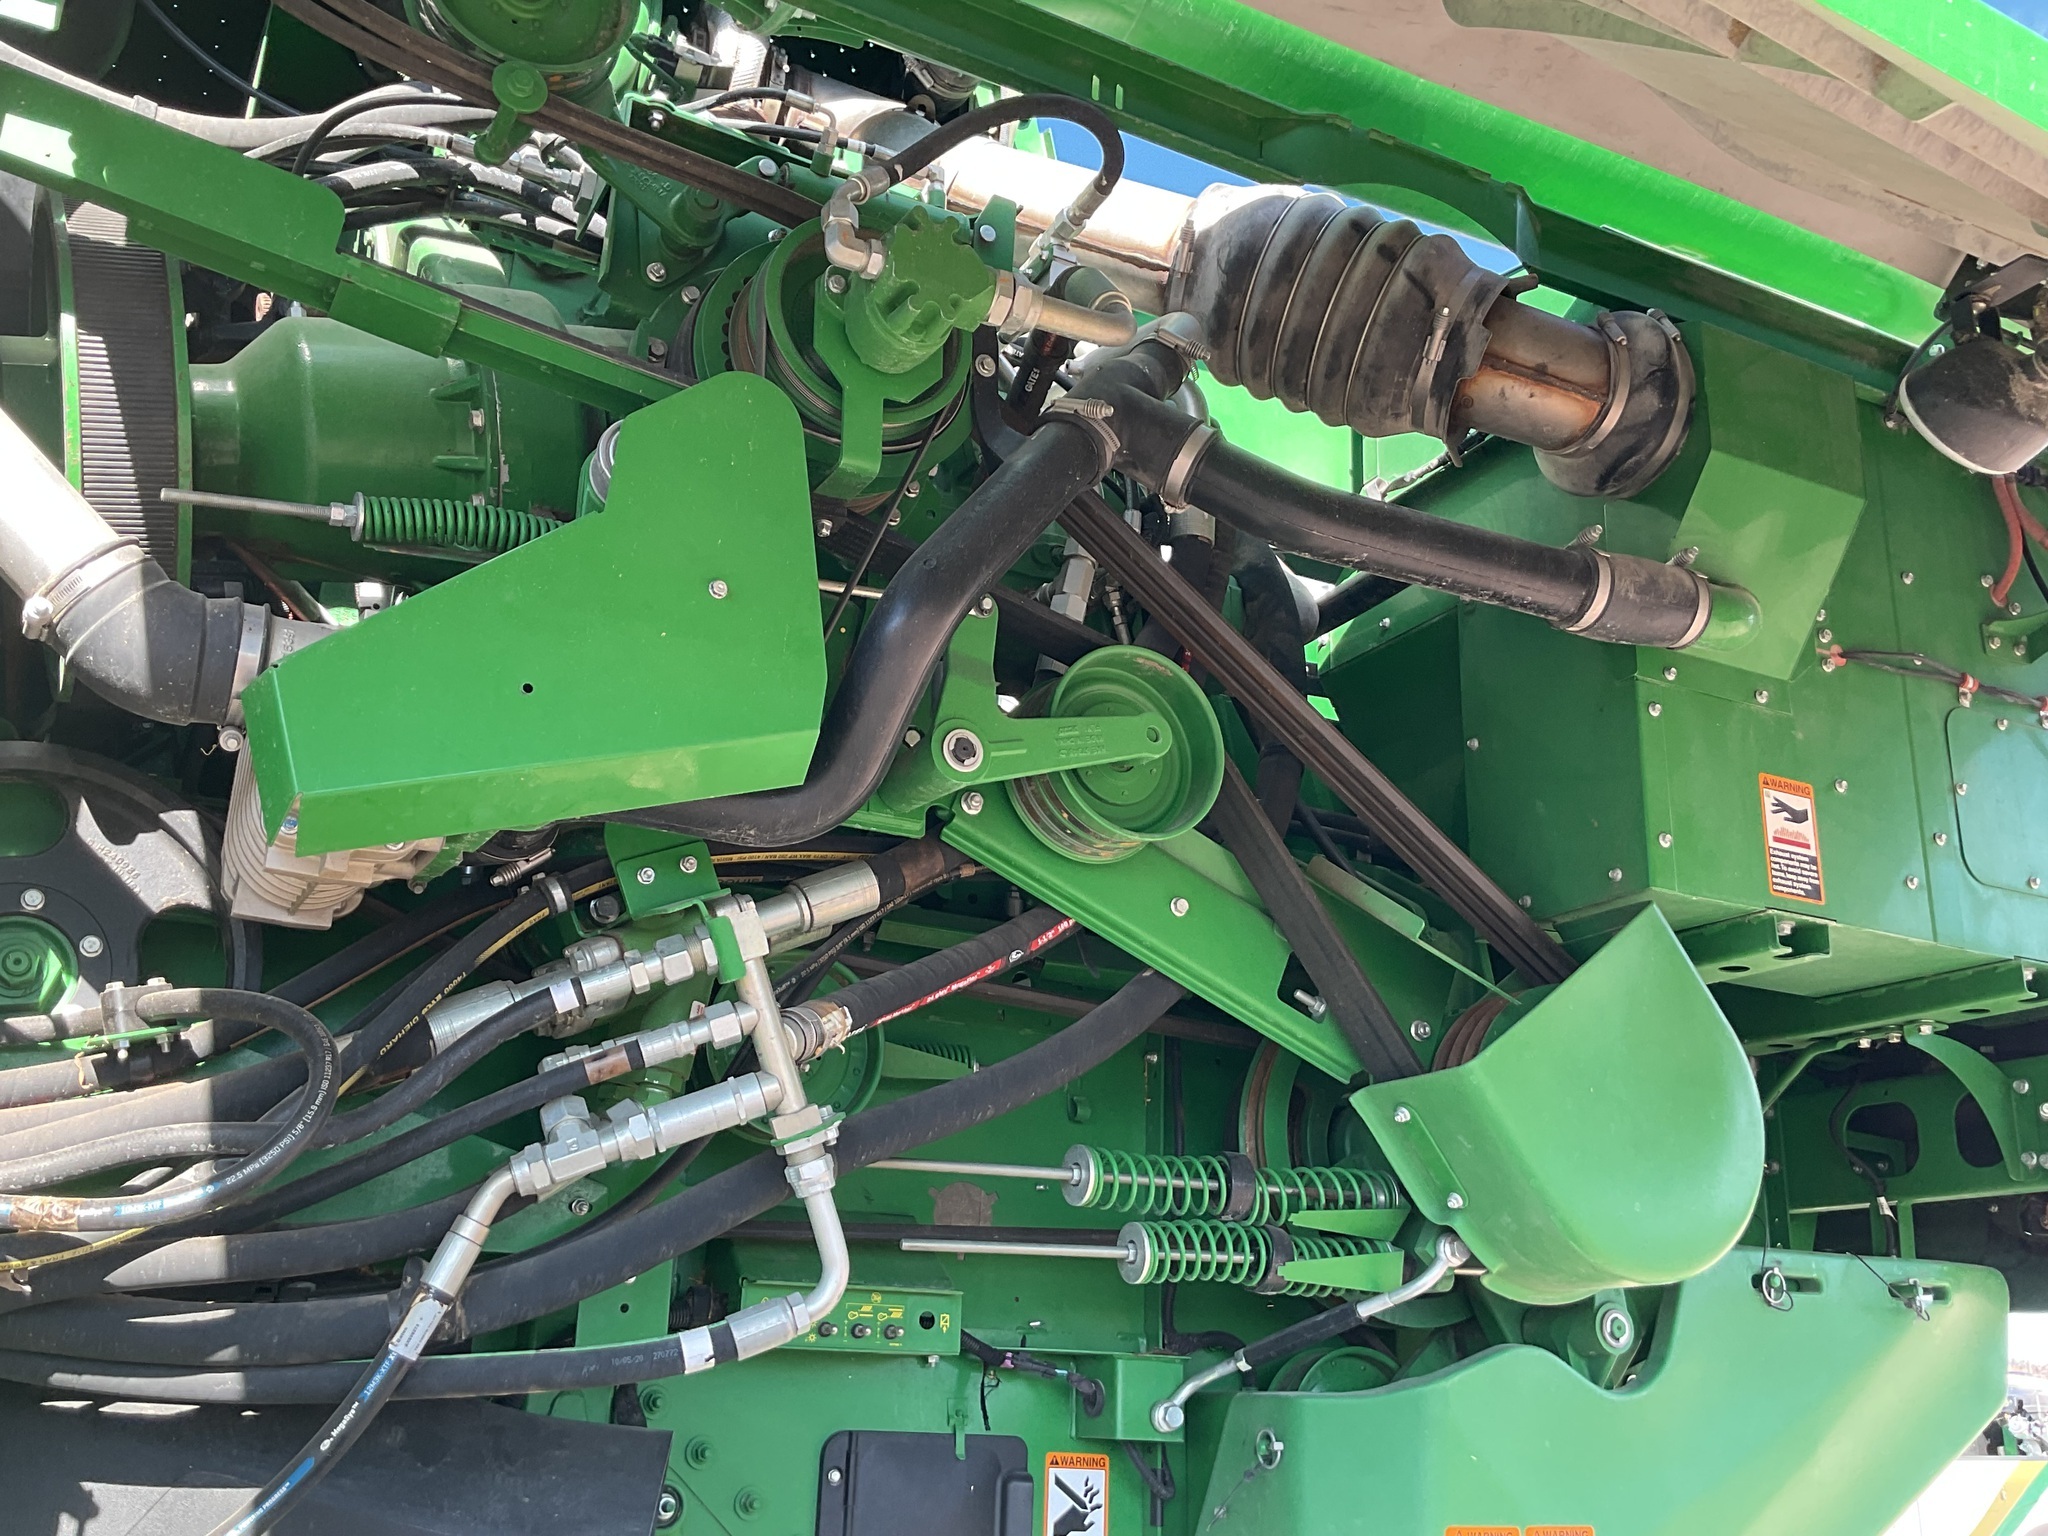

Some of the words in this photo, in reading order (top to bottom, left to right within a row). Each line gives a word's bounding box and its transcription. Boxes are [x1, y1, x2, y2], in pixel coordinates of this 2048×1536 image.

[1770, 780, 1810, 795] WARNING
[379, 1015, 420, 1056] DIEHARD
[324, 1061, 333, 1080] 11237
[320, 1079, 330, 1091] ISO
[243, 1161, 260, 1176] MPa
[225, 1170, 243, 1185] 22.5
[1060, 1456, 1105, 1468] WARNING
